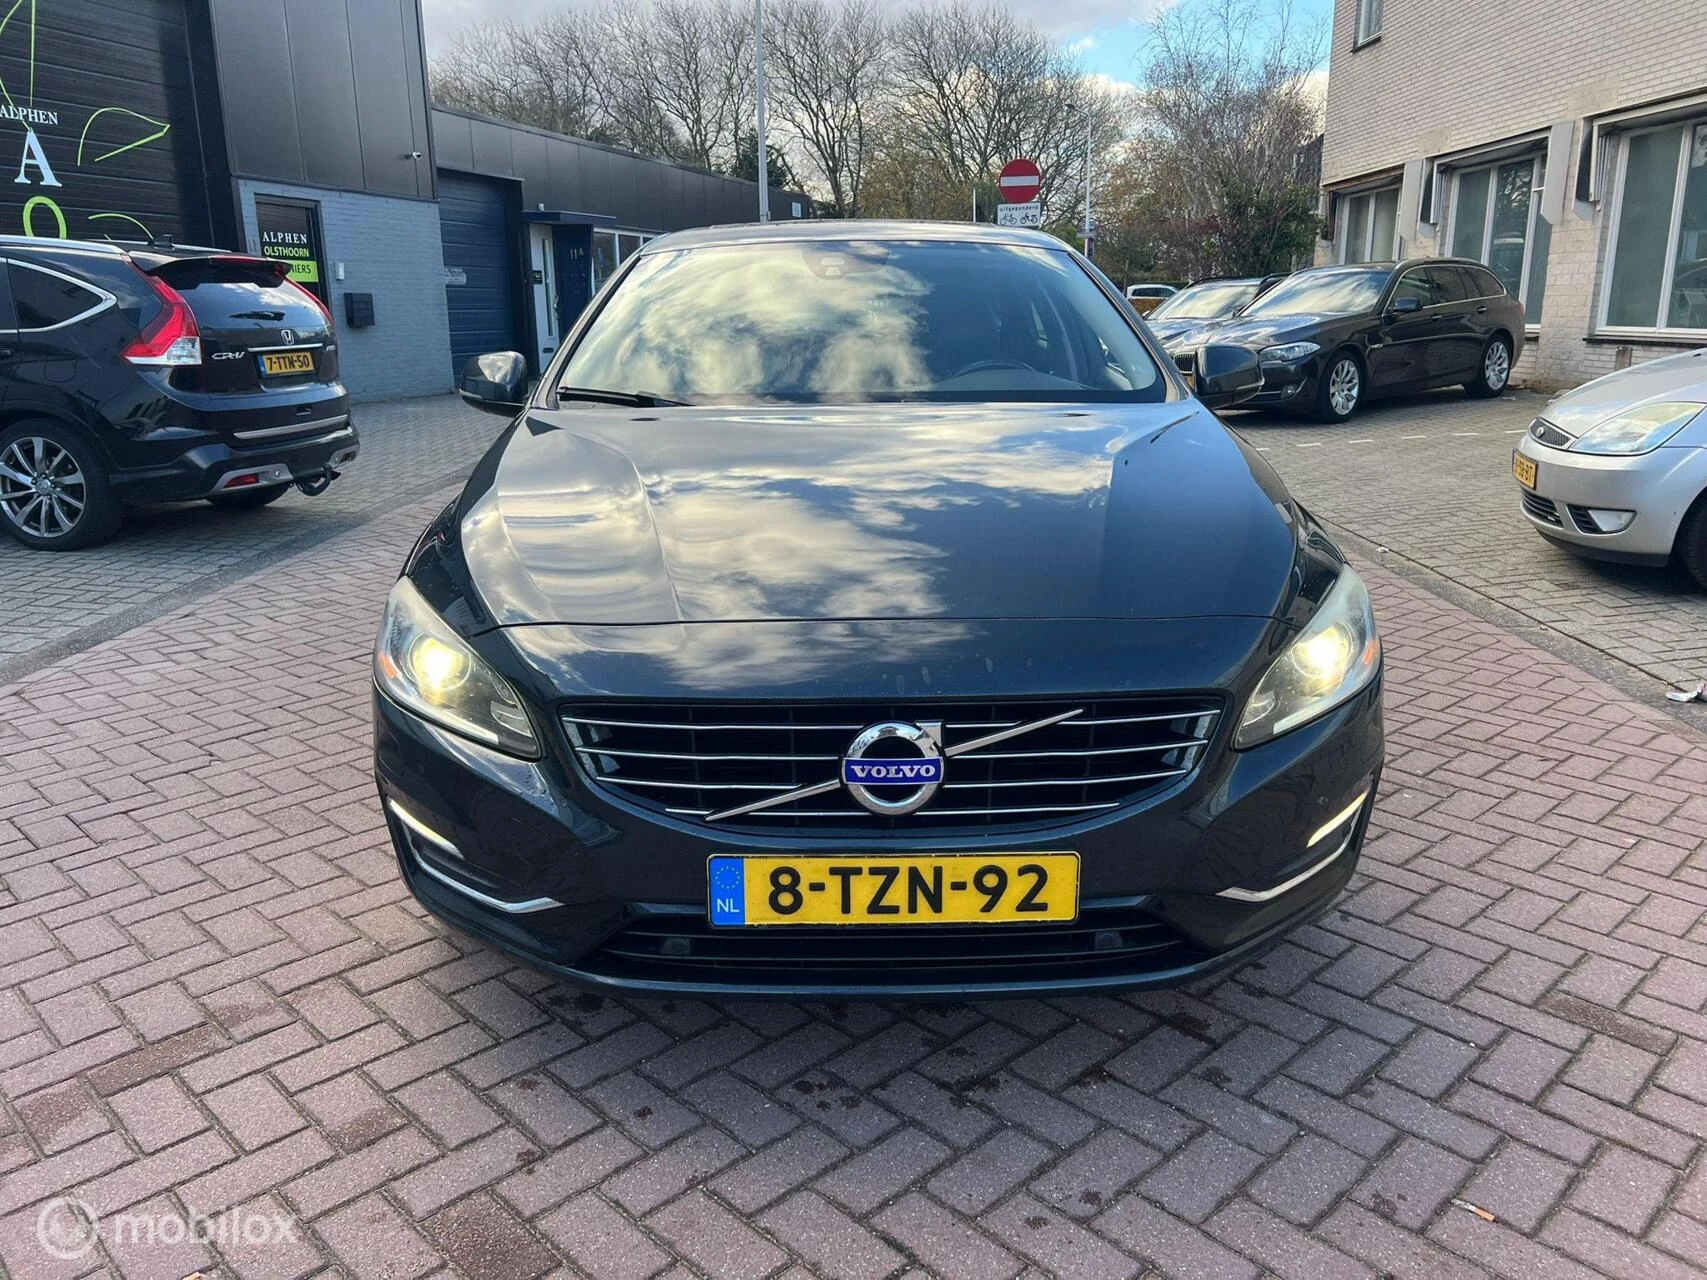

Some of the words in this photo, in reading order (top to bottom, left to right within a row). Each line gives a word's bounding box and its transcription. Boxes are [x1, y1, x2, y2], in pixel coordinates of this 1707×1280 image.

[0, 104, 58, 125] ALPHEN
[14, 128, 62, 187] A
[262, 231, 307, 244] ALPHEN
[264, 245, 310, 258] OLSTHOORN
[290, 264, 312, 275] NIERS
[266, 354, 310, 372] 7-TTN-50
[850, 765, 936, 778] VOLVO
[767, 863, 1049, 915] 8-TZN-92
[716, 898, 740, 913] NL
